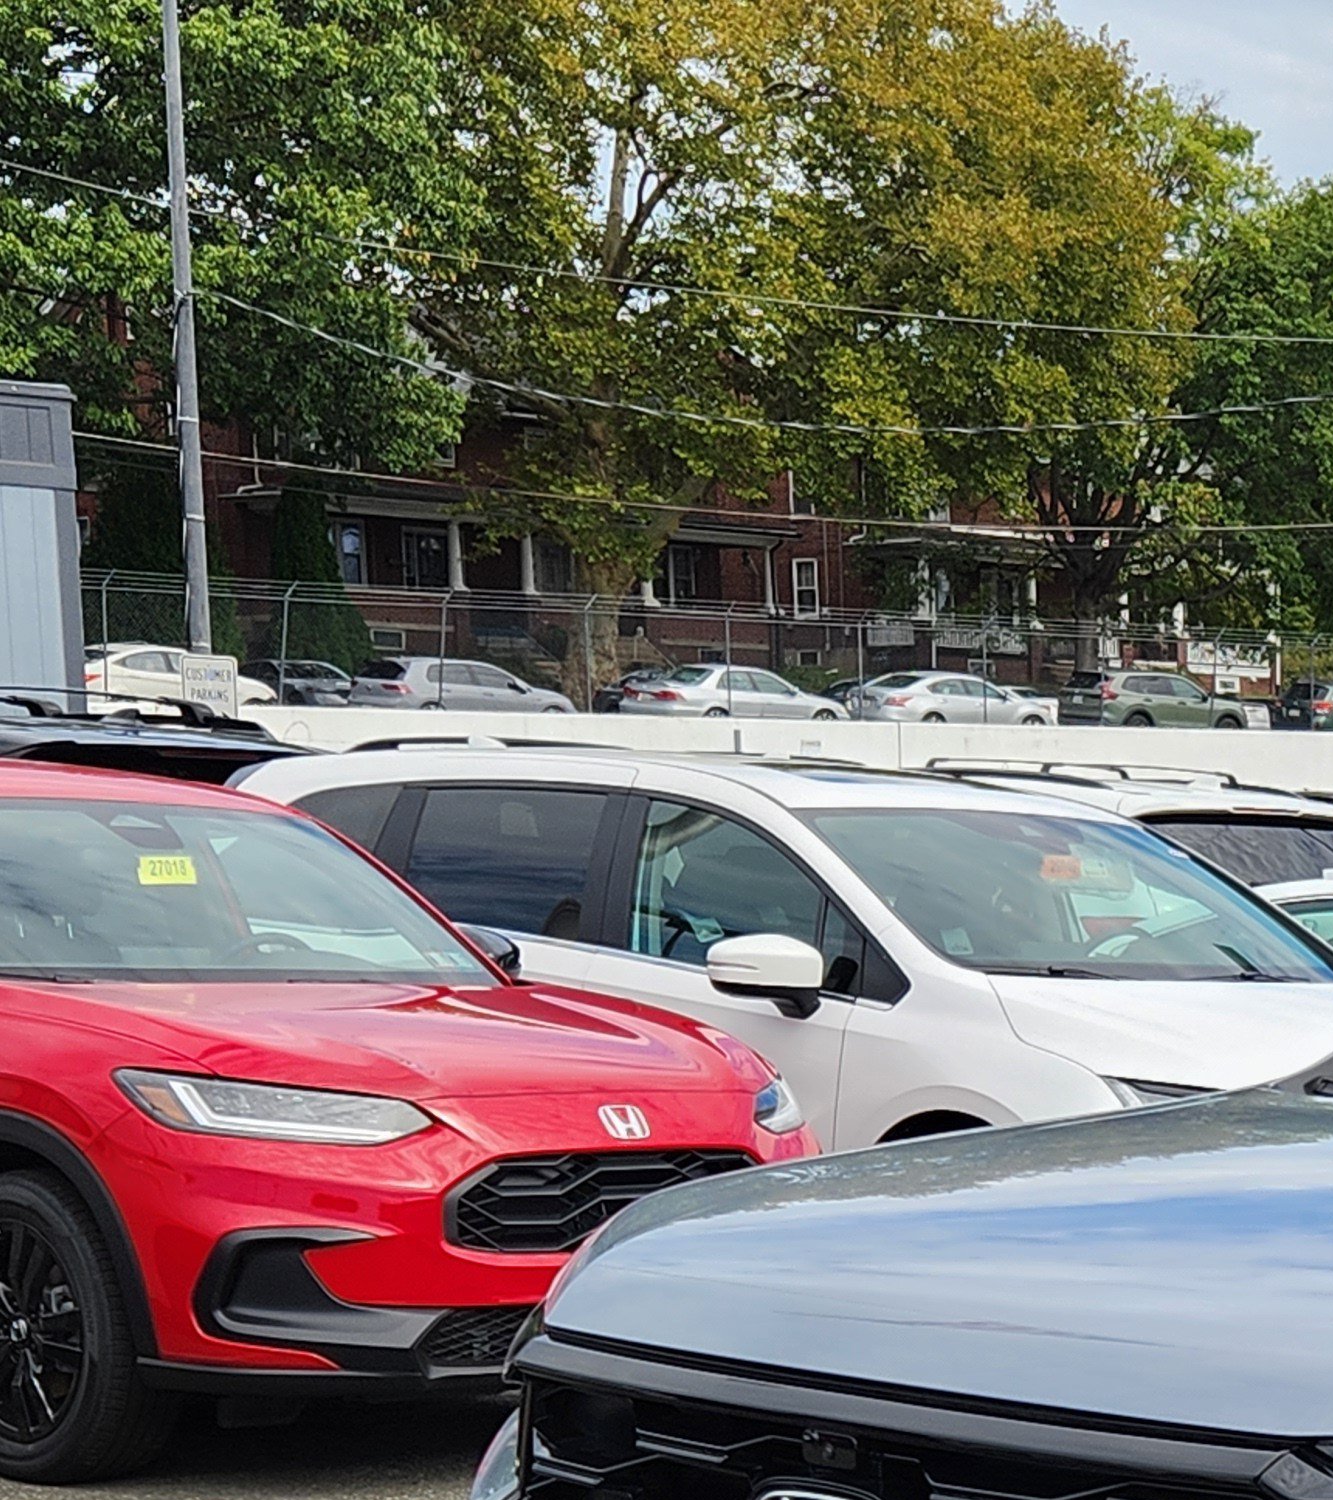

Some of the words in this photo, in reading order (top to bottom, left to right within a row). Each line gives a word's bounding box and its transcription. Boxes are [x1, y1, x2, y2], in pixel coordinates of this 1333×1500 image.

[186, 667, 232, 682] CUSTOMER
[190, 687, 229, 703] PARKING
[148, 859, 188, 876] 27018
